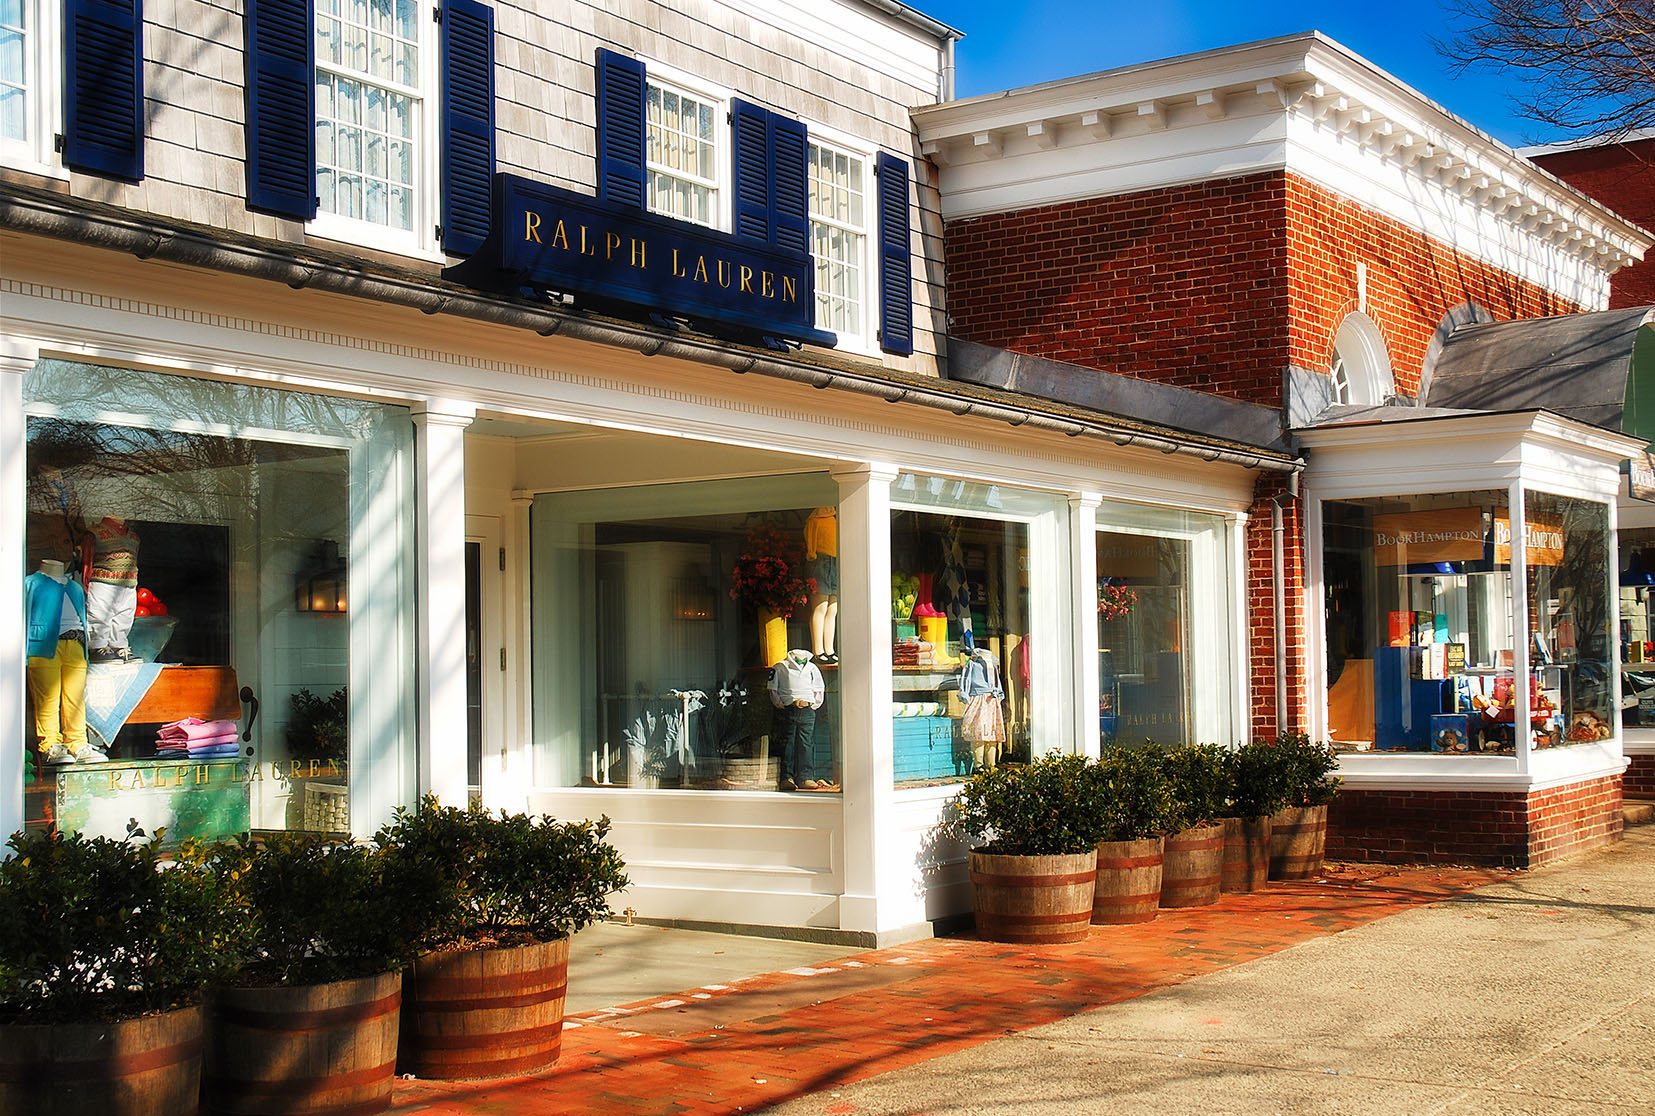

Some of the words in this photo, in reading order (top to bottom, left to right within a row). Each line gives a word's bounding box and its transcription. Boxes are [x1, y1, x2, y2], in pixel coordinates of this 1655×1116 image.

[524, 210, 648, 269] RALPH
[671, 247, 797, 304] LAUREN
[1495, 521, 1563, 550] BOHAMPTON
[107, 763, 211, 792] RALPH
[231, 757, 342, 783] LAUREN
